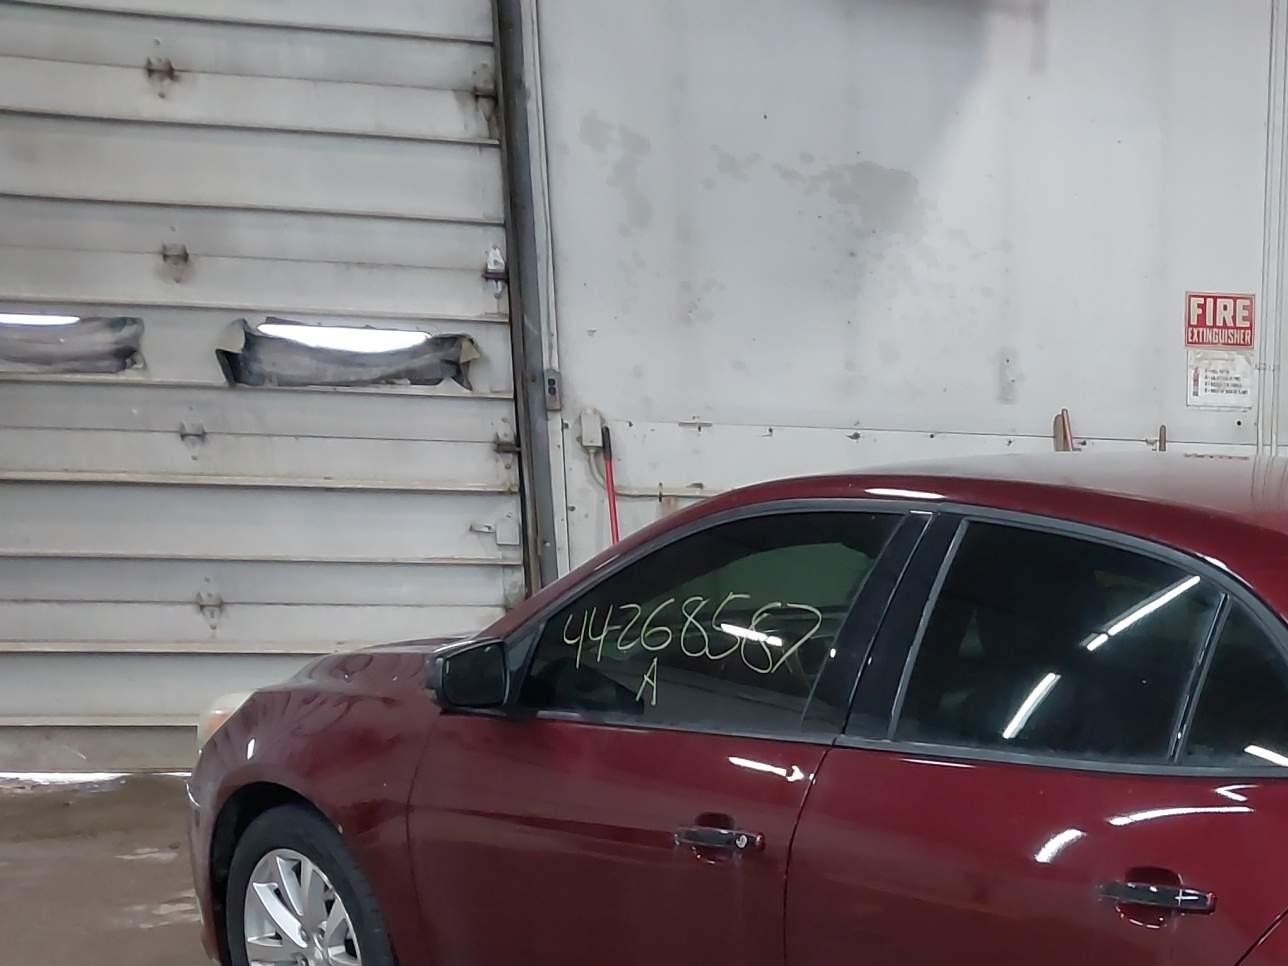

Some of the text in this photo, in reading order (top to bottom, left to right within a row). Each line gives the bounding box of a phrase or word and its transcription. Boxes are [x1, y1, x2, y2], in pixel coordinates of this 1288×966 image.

[1190, 297, 1250, 327] FIRE
[1188, 328, 1251, 345] EXTINGUISHER
[563, 591, 823, 674] 44268587
[636, 657, 658, 706] A
